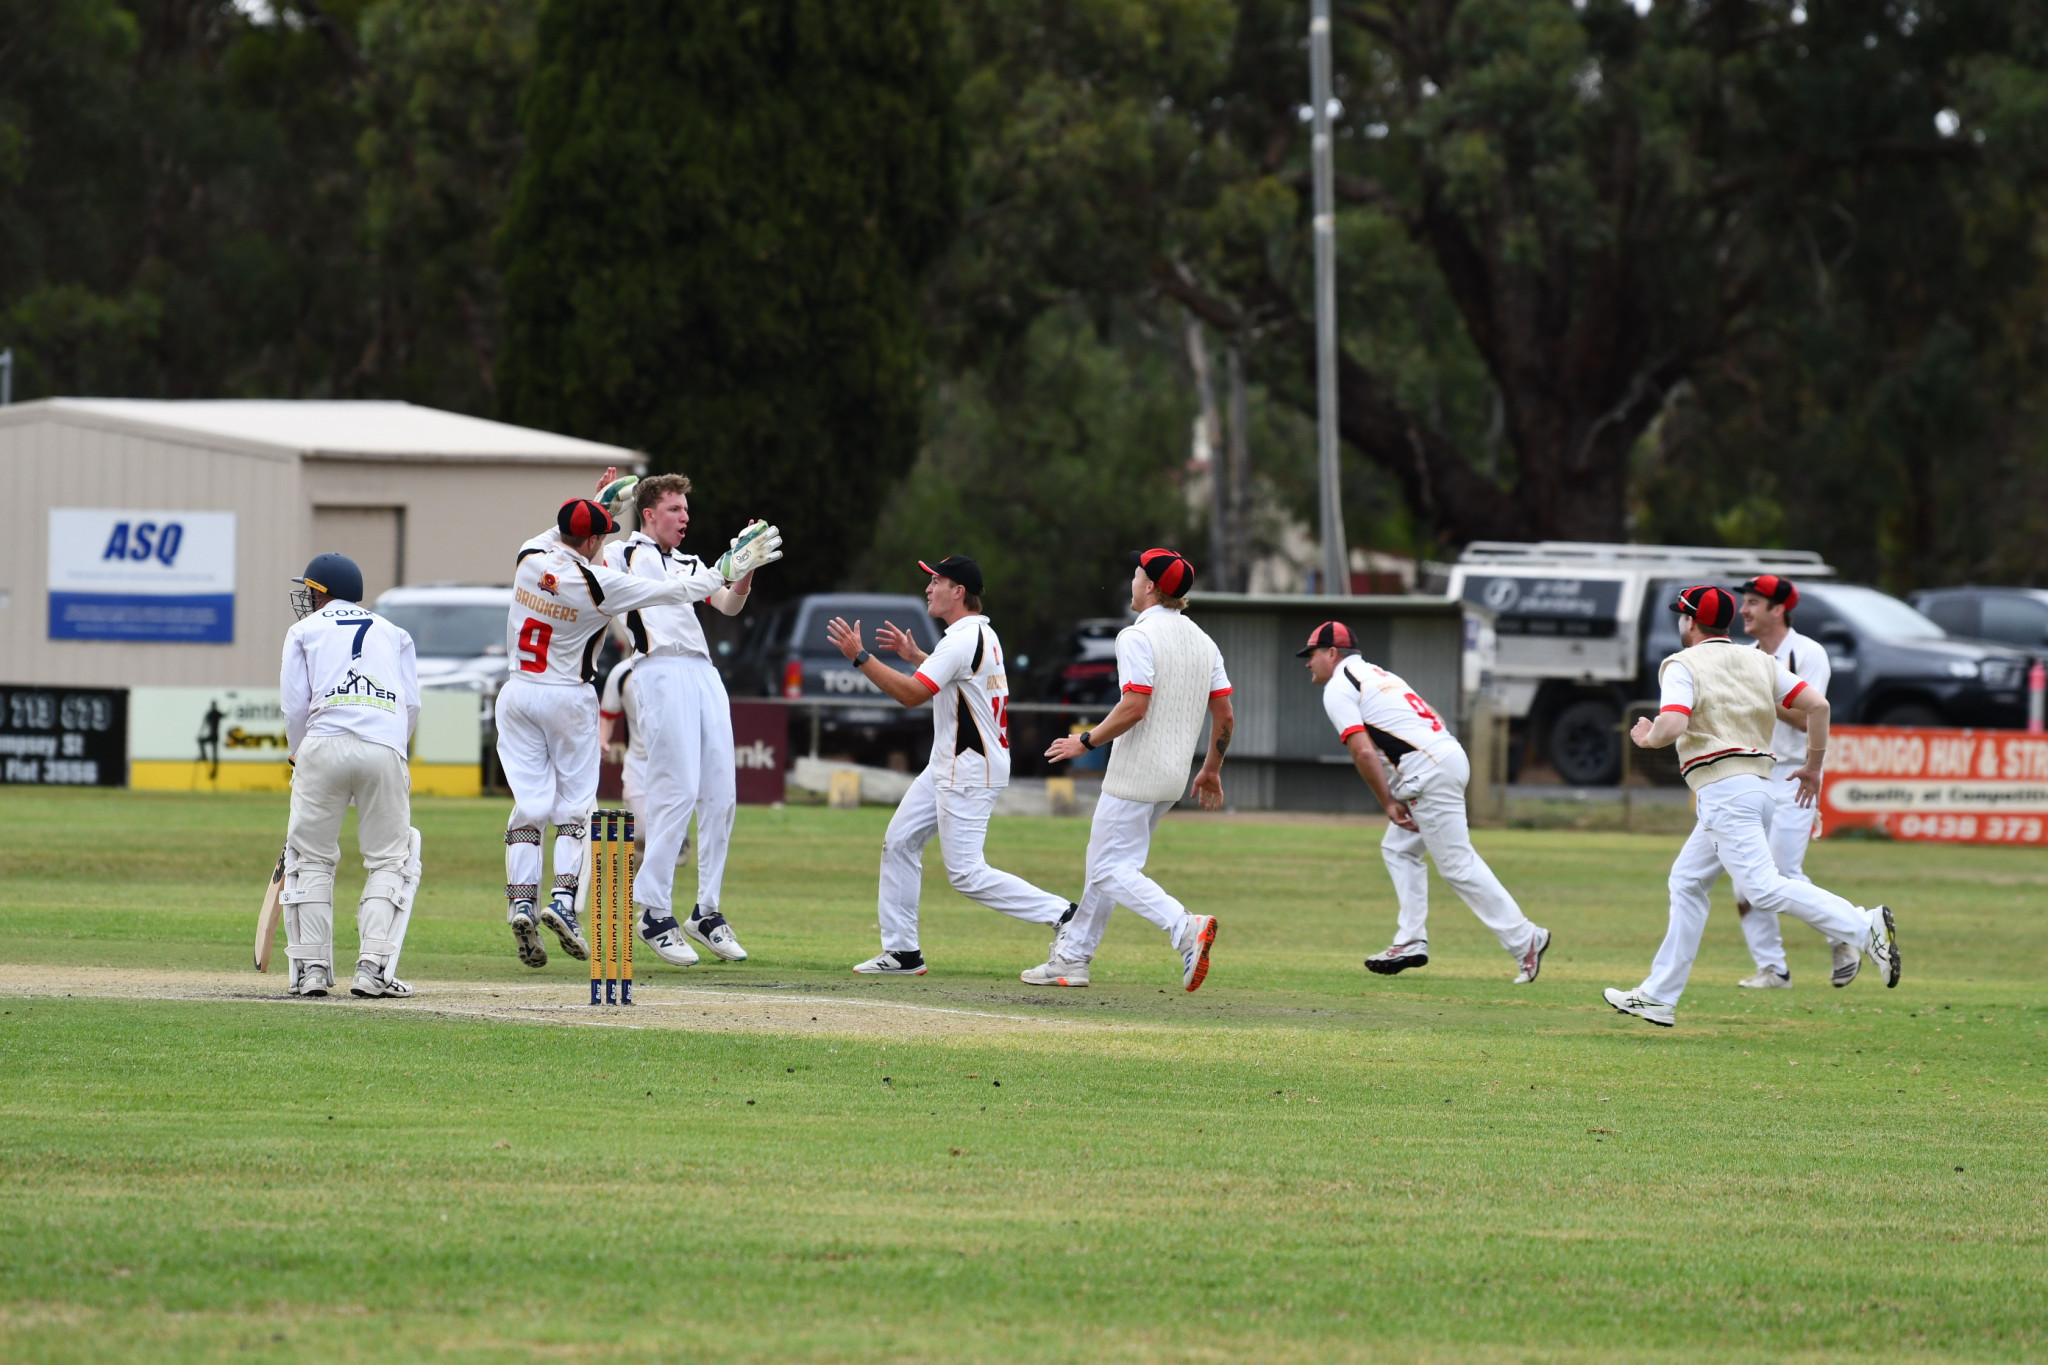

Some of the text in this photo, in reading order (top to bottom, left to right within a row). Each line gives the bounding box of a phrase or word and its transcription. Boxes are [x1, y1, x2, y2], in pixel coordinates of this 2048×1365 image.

[103, 522, 183, 567] ASQ
[515, 586, 579, 623] BROOKERS
[335, 618, 374, 661] 7
[518, 617, 553, 674] 9
[1824, 735, 1925, 775] BENDIGO
[1928, 738, 1976, 776] HAY
[1977, 738, 1998, 777] &
[1848, 786, 1913, 806] Quality
[1900, 814, 2043, 842] 0438 373
